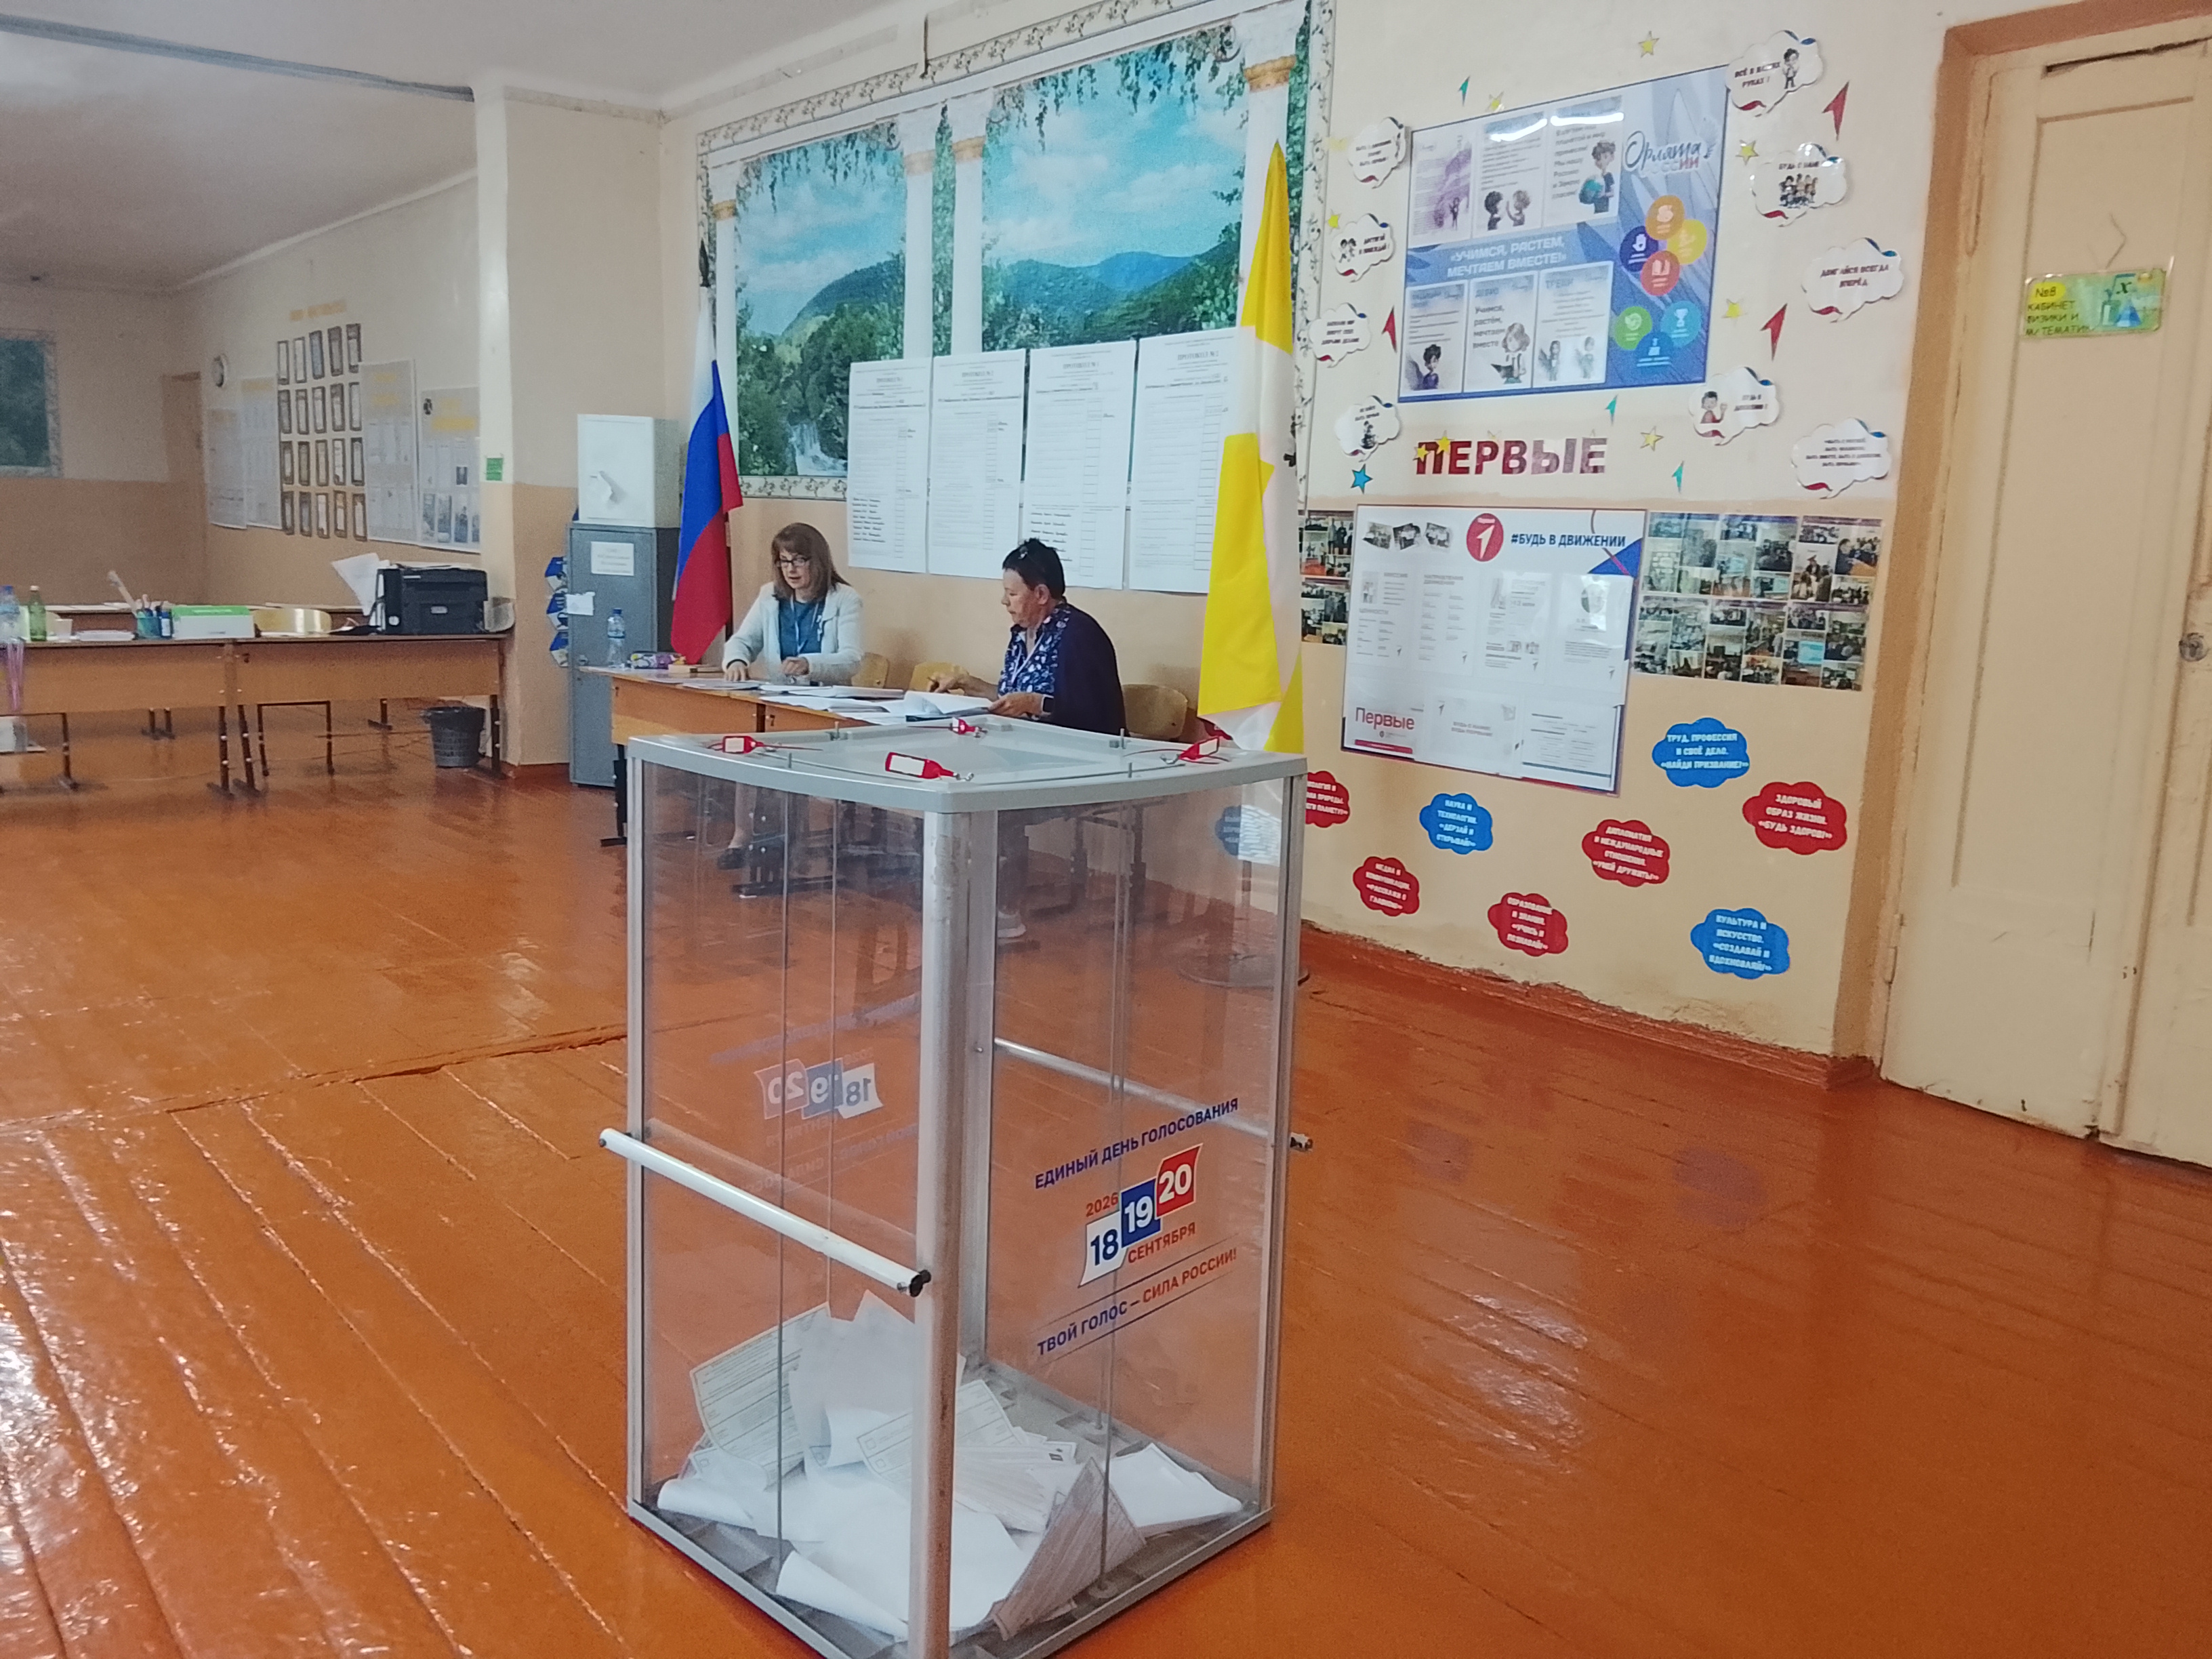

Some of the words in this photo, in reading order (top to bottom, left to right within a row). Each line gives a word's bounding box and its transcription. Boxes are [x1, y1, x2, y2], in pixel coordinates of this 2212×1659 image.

[1625, 130, 1701, 171] Орлята
[1447, 260, 1504, 278] МЕЧТАЕМ
[1416, 438, 1607, 474] ПЕРВЫЕ
[1511, 533, 1547, 548] #БУДЬ
[1549, 534, 1557, 545] В
[1558, 534, 1626, 548] ДВИЖЕНИИ
[1355, 707, 1415, 730] Первые
[1691, 733, 1738, 742] ПРОФЕССИЯ
[1765, 806, 1793, 819] ОБРАЗ
[1775, 794, 1822, 809] ЗДОРОВЫЙ
[1716, 914, 1759, 929] КУЛЬТУРА
[1035, 1148, 1099, 1189] ЕДИНЫЙ
[1101, 1136, 1139, 1165] ДЕНЬ
[1141, 1097, 1239, 1147] ГОЛОСОВАНИЯ
[1086, 1191, 1120, 1218] 2026
[1090, 1228, 1120, 1267] 18
[1124, 1195, 1153, 1234] 19
[1158, 1163, 1193, 1205] 20
[1127, 1221, 1196, 1264] СЕНТЯБРЯ
[1037, 1322, 1078, 1356] ТВОЙ
[1080, 1300, 1128, 1335] ГОЛОС
[1143, 1275, 1179, 1303] СИЛА
[1181, 1247, 1237, 1286] РОССИИ!
